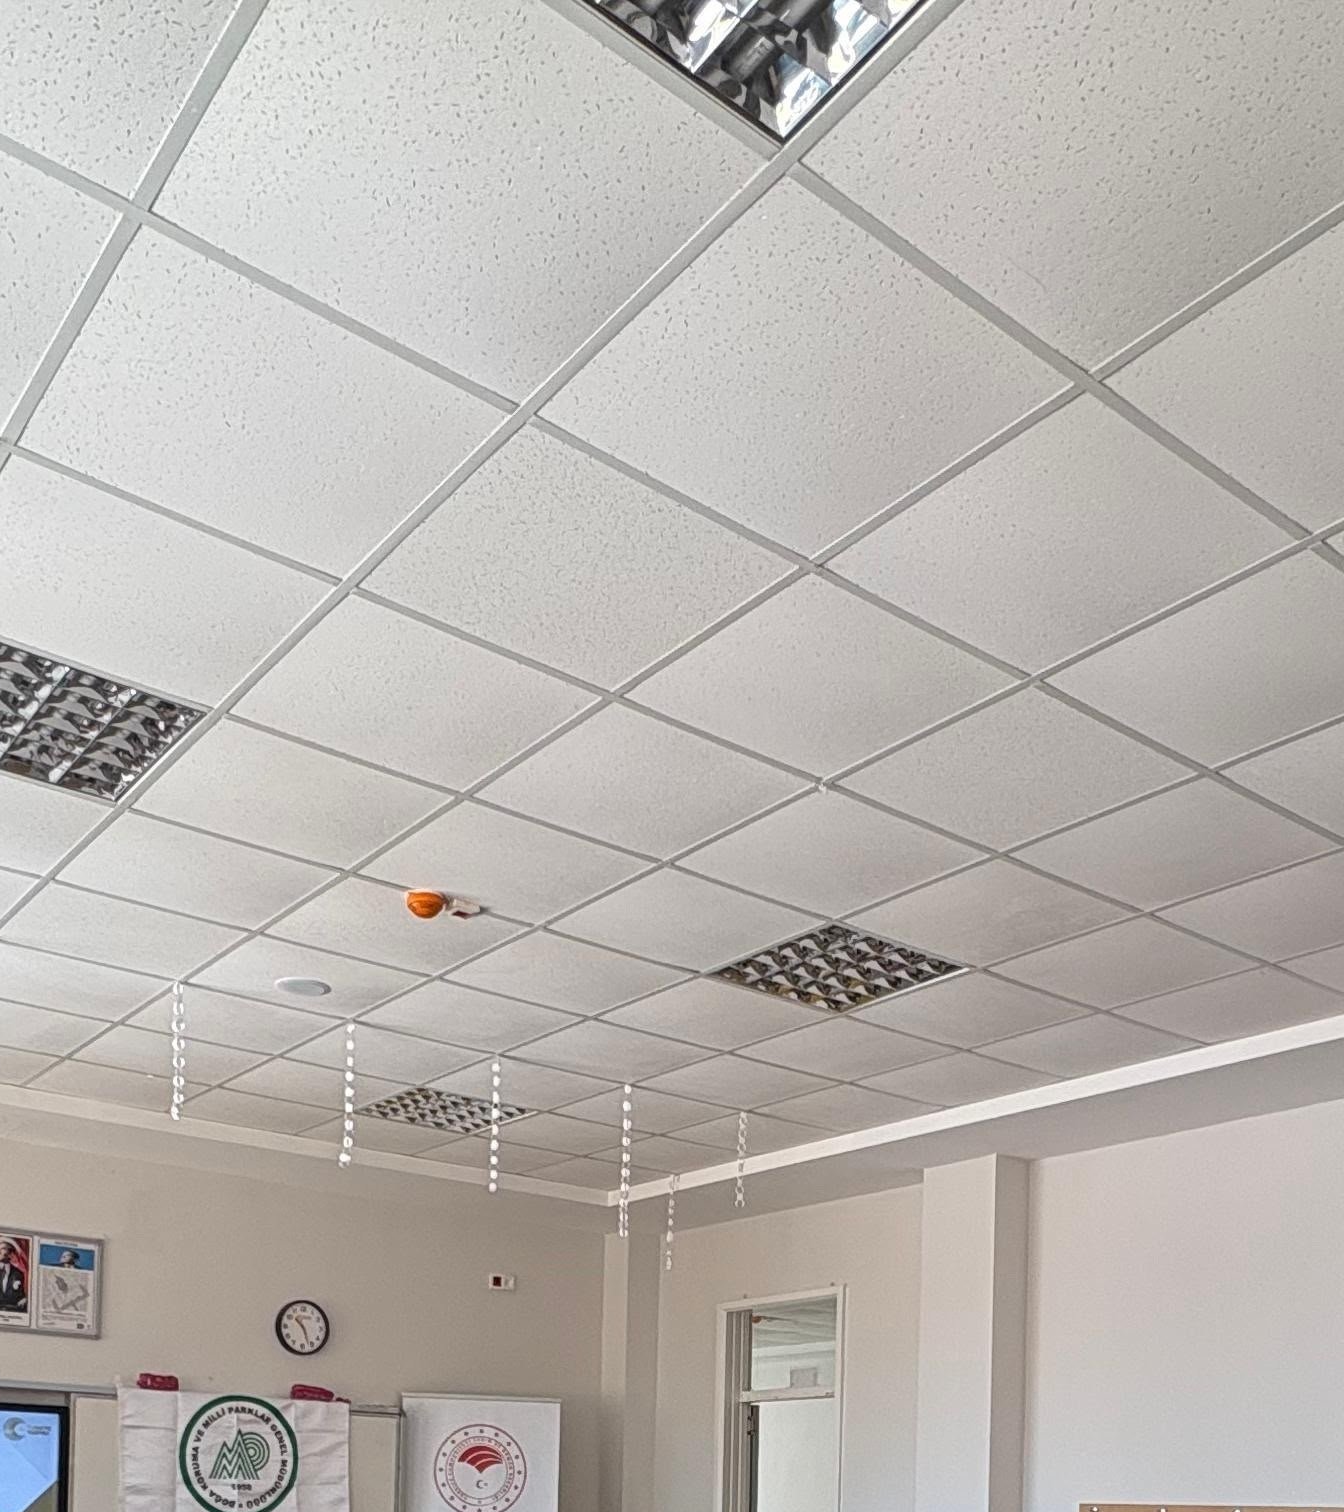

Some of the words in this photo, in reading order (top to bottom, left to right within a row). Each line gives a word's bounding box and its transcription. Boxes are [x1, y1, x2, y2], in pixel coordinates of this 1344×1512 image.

[202, 1407, 226, 1430] MİLLİ
[227, 1406, 272, 1425] PARKLAR
[193, 1429, 205, 1443] VE
[270, 1424, 288, 1456] GENEL
[191, 1446, 209, 1492] KORUMA
